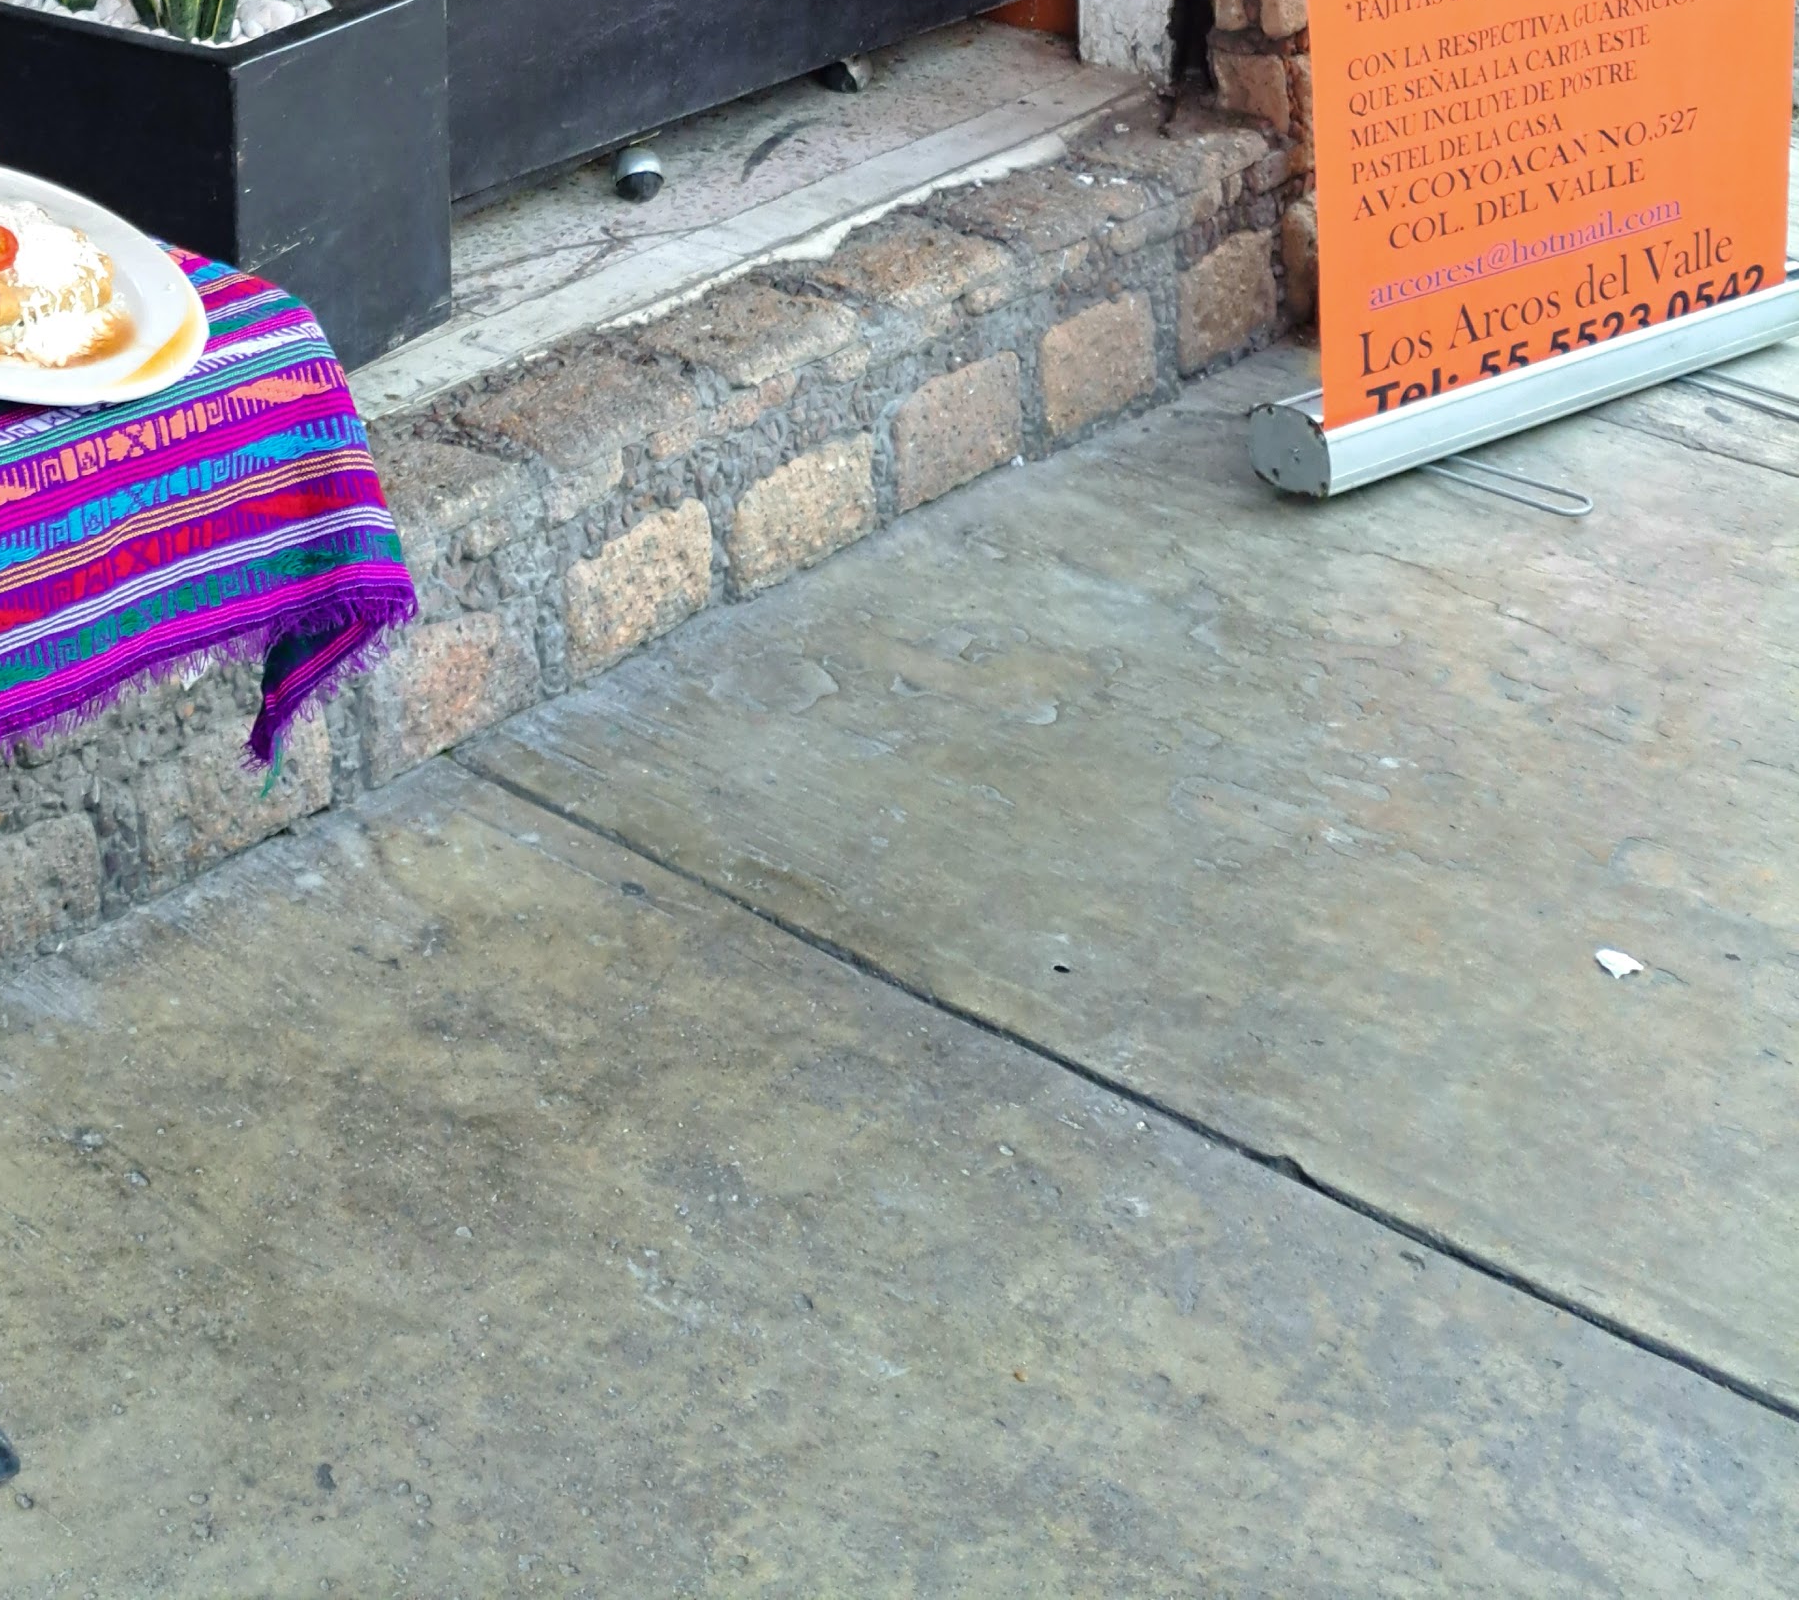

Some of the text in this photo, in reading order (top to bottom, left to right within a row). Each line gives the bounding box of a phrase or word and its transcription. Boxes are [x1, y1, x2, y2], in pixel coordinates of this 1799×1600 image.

[1347, 49, 1398, 82] CON
[1405, 43, 1431, 69] LA
[1438, 13, 1571, 61] RESPECTIVA
[1349, 24, 1651, 118] QUE SEÑALA LA CARTA ESTE
[1350, 59, 1638, 151] MENU INCLUYE DE POSTRE
[1351, 112, 1563, 185] PASTEL DE LA CASA
[1389, 158, 1646, 249] COL. DEL VALLE
[1368, 199, 1682, 311] arcorest@hotmail.com
[1359, 228, 1734, 377] Los Arcos del Valle
